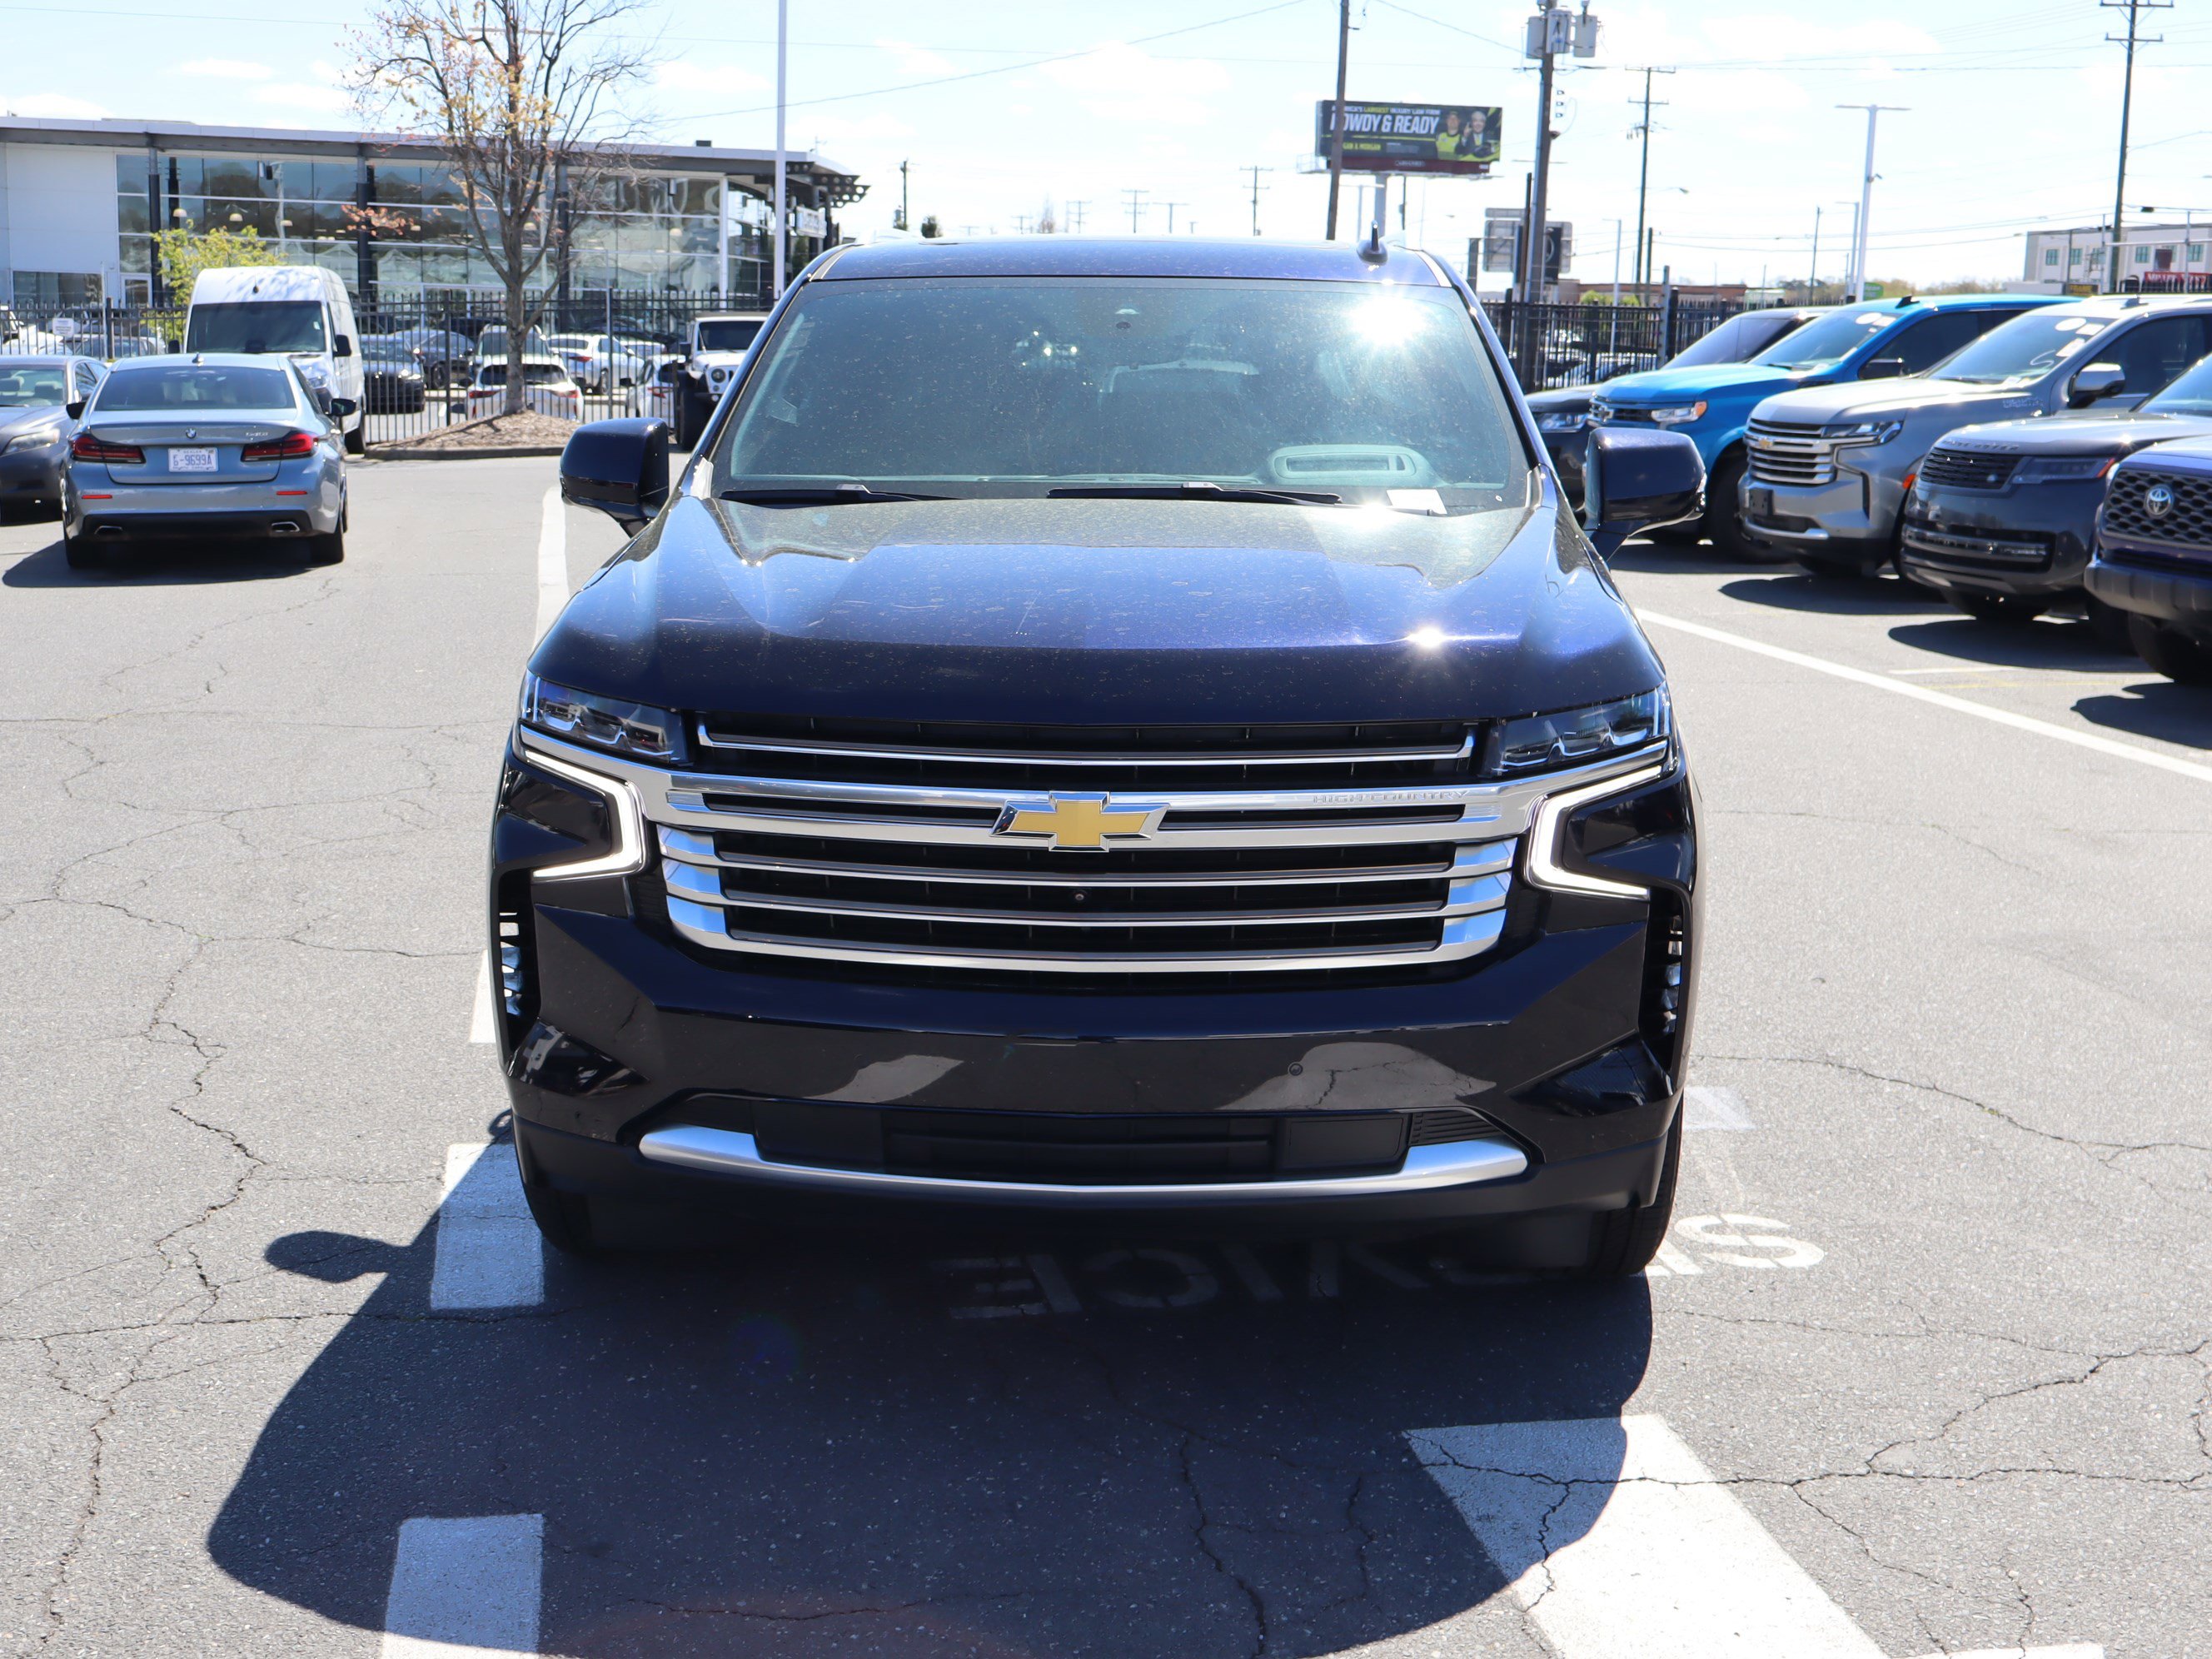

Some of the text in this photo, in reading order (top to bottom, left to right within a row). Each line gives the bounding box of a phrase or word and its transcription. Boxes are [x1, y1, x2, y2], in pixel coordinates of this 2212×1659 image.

[1393, 115, 1440, 134] READY
[1313, 790, 1470, 804] HIGH COUNTRY
